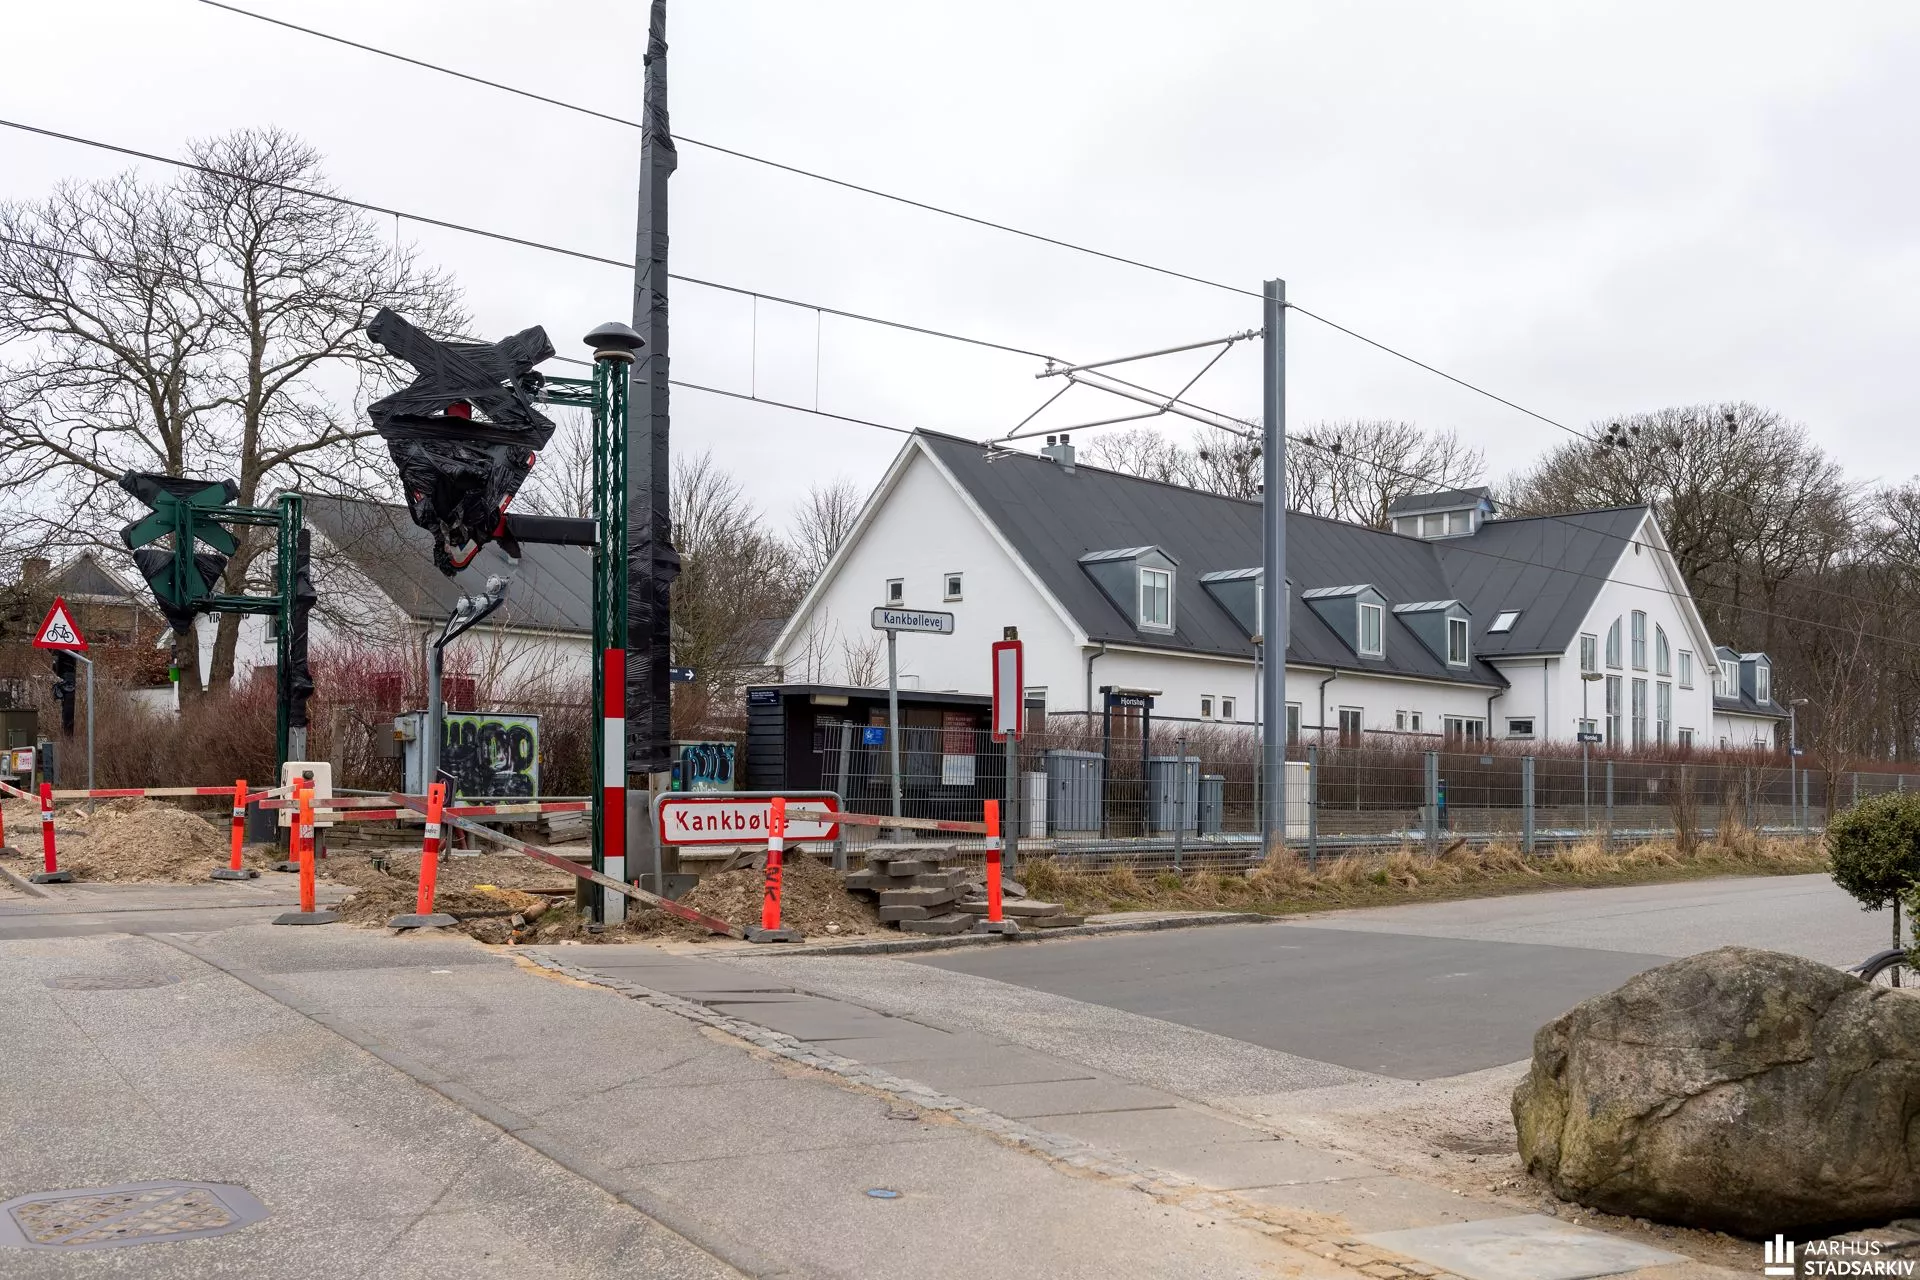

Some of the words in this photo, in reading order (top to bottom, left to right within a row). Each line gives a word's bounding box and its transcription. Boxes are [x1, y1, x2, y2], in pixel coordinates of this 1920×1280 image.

[884, 611, 943, 631] Kankbøllevej
[1120, 697, 1145, 707] Hjortshøj
[676, 809, 790, 831] Kankbøl
